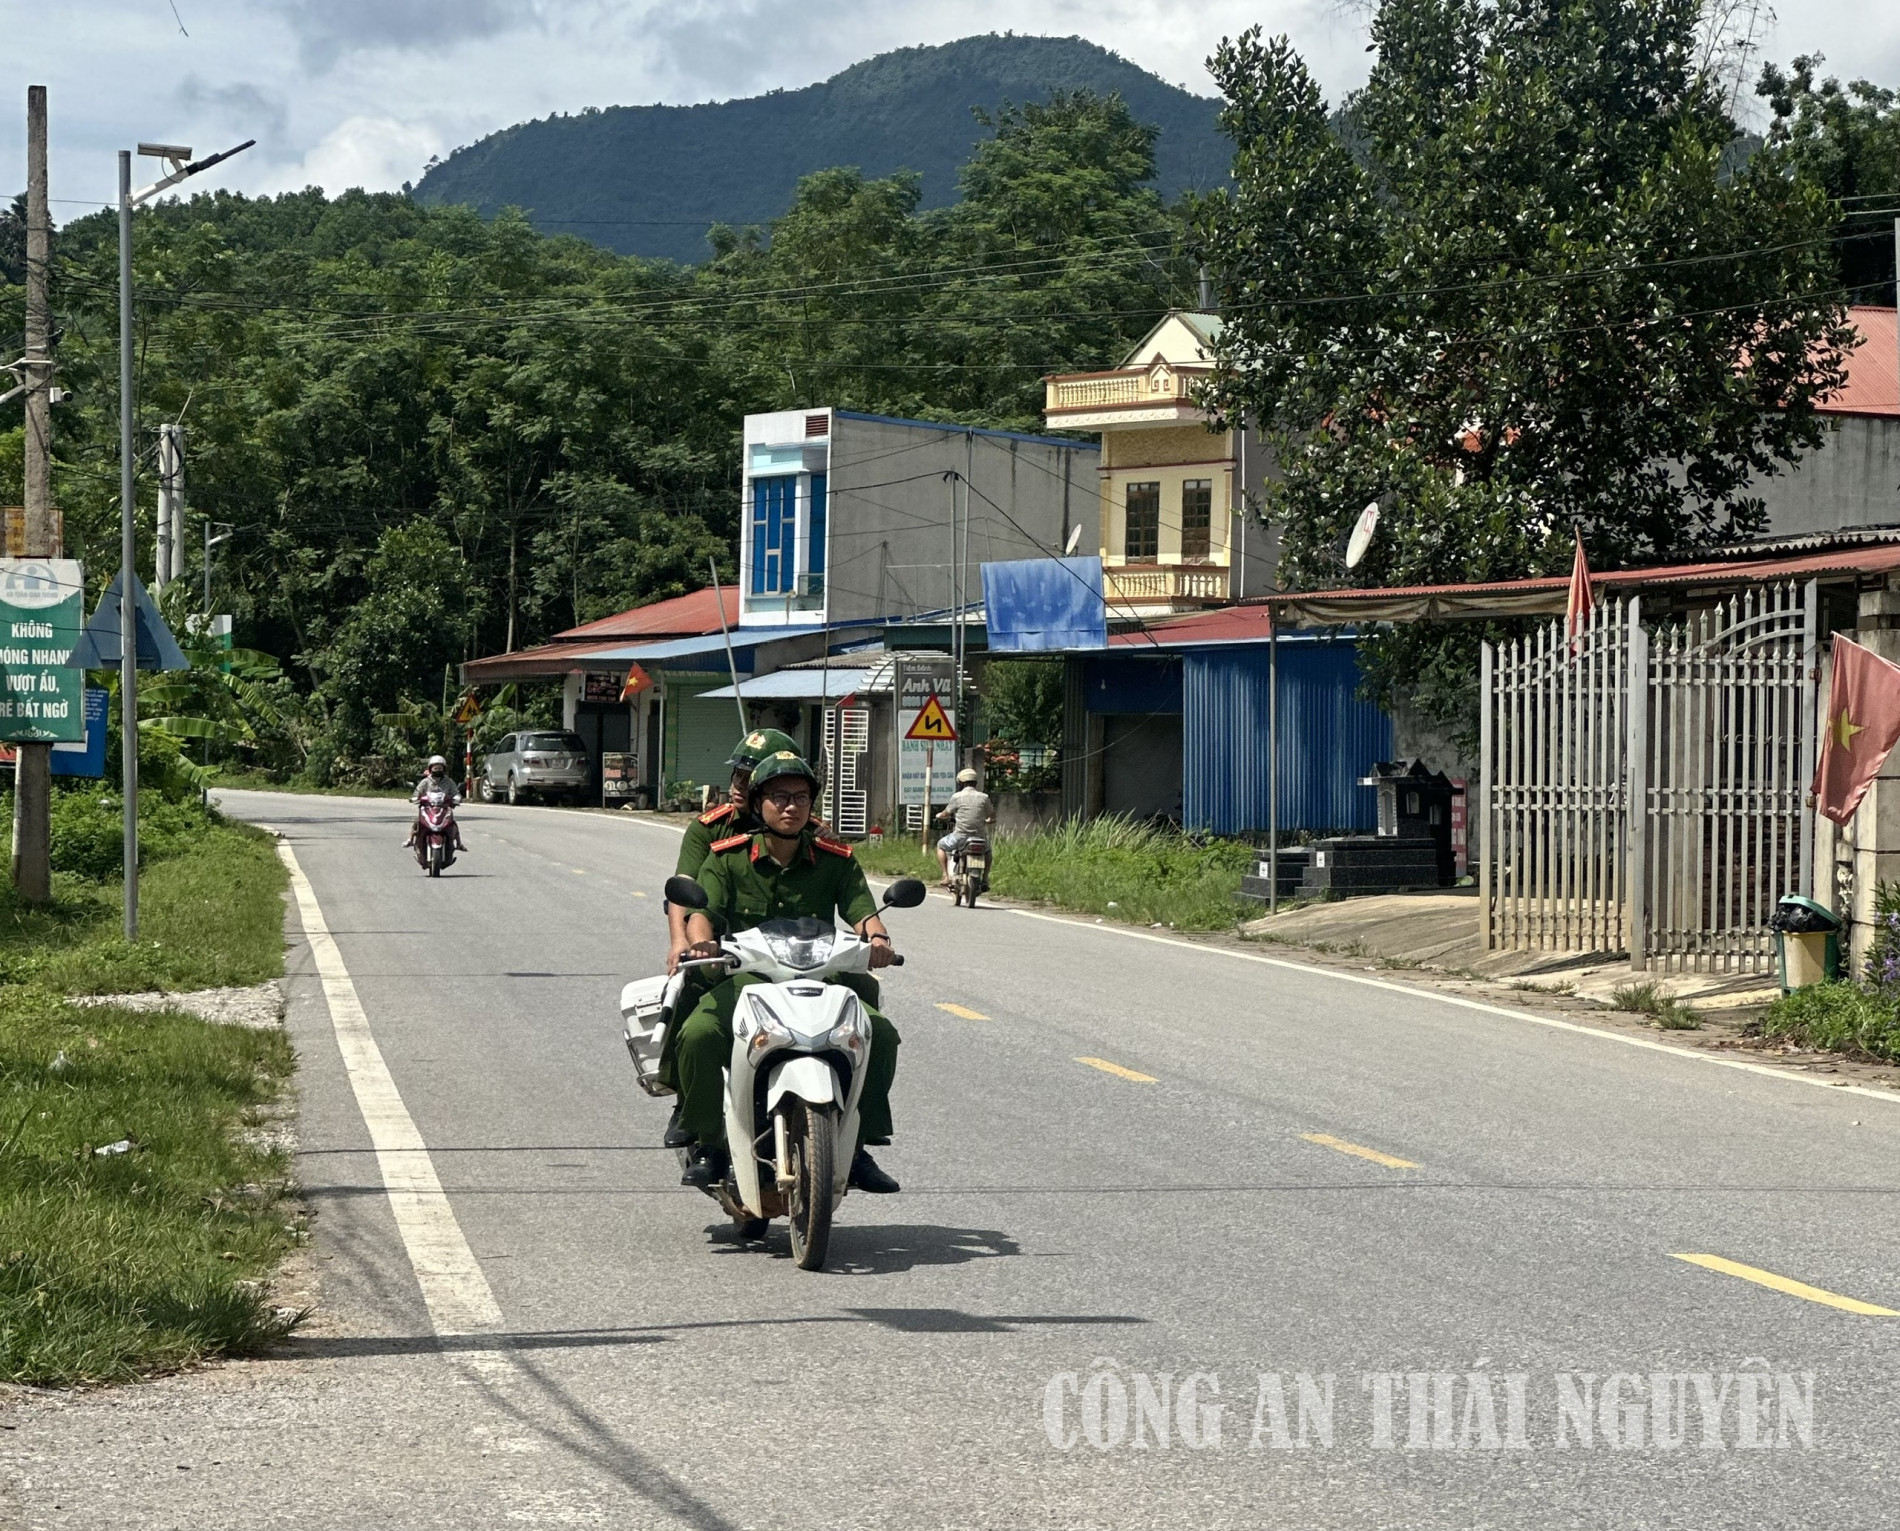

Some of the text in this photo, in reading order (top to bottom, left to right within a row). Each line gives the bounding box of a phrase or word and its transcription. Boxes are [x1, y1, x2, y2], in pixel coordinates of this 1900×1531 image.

[11, 619, 53, 638] KHÔNG
[0, 646, 29, 665] ÓNG
[6, 673, 36, 695] VƯỢT
[901, 678, 930, 693] Anh
[17, 697, 40, 718] BẤT
[43, 699, 69, 718] NGỜ
